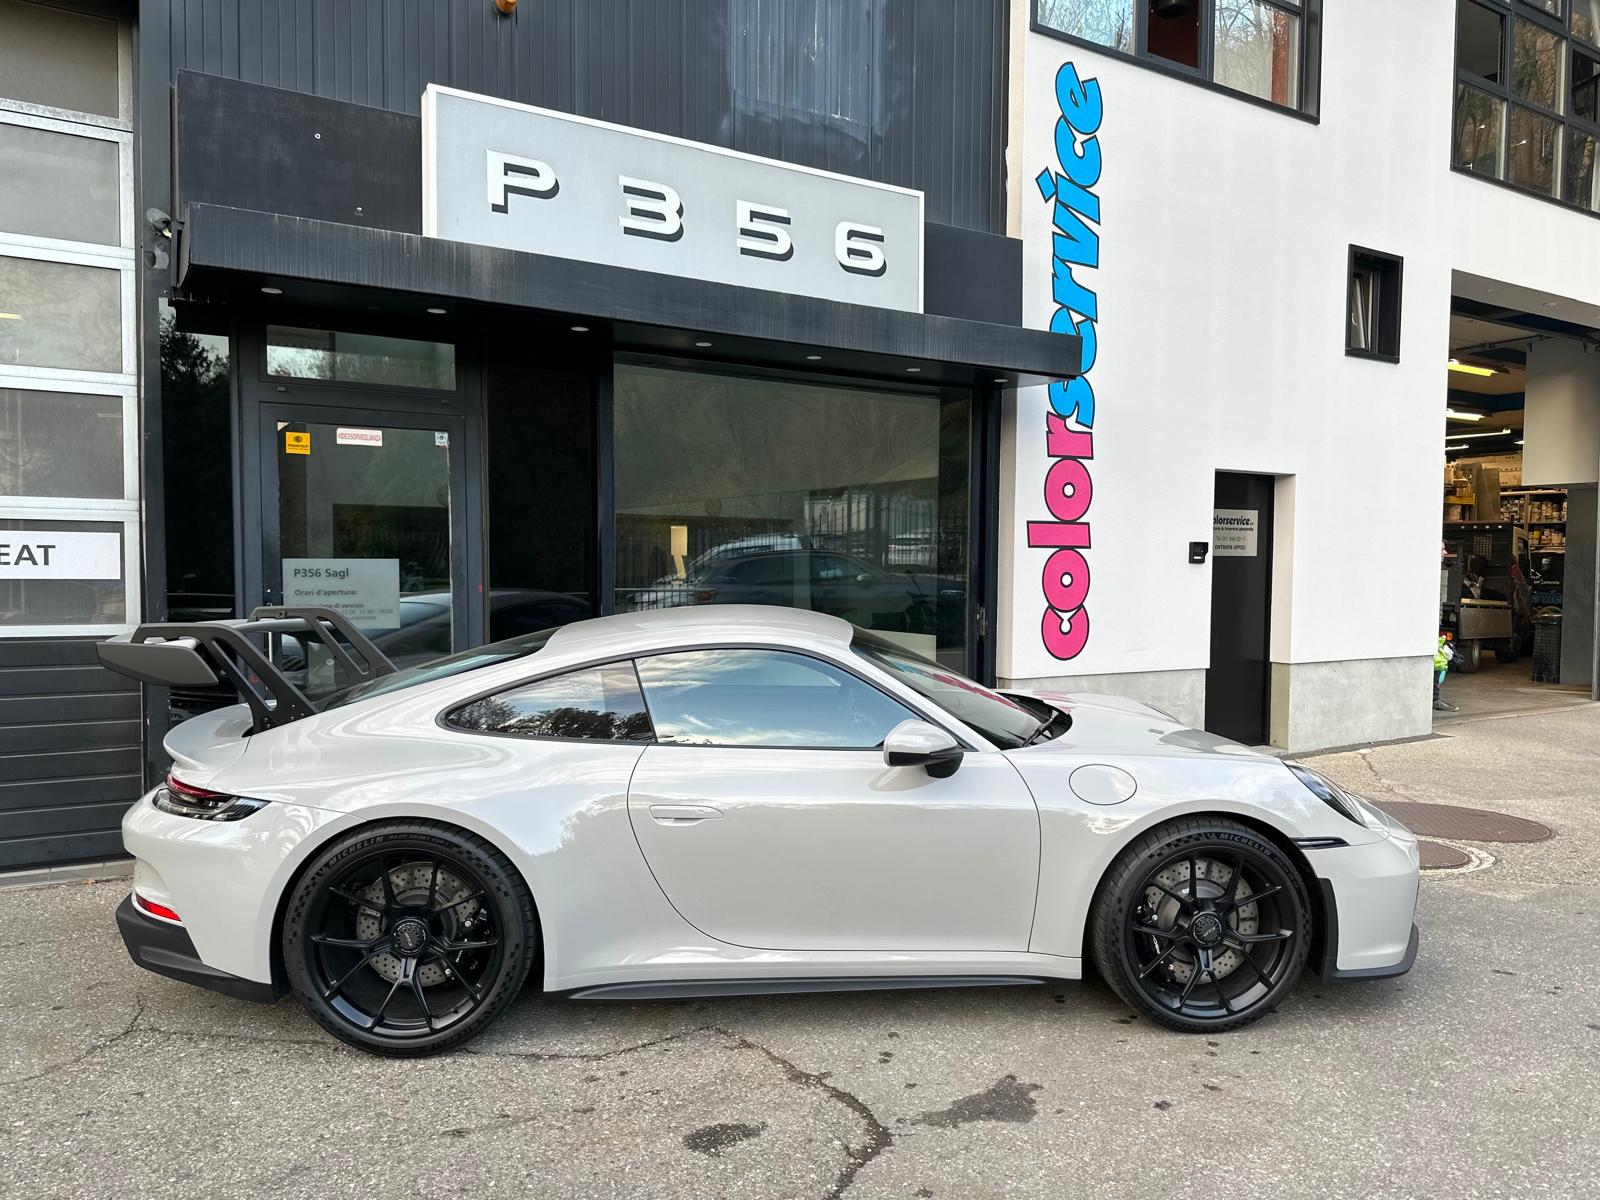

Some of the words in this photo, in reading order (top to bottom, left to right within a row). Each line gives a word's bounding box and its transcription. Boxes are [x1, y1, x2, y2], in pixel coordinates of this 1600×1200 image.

[1027, 61, 1103, 661] colorservice
[0, 544, 56, 566] EAT
[294, 568, 321, 577] P356
[325, 567, 349, 579] Sagl
[328, 835, 384, 866] MICHELIN
[1219, 833, 1272, 856] MICHELIN
